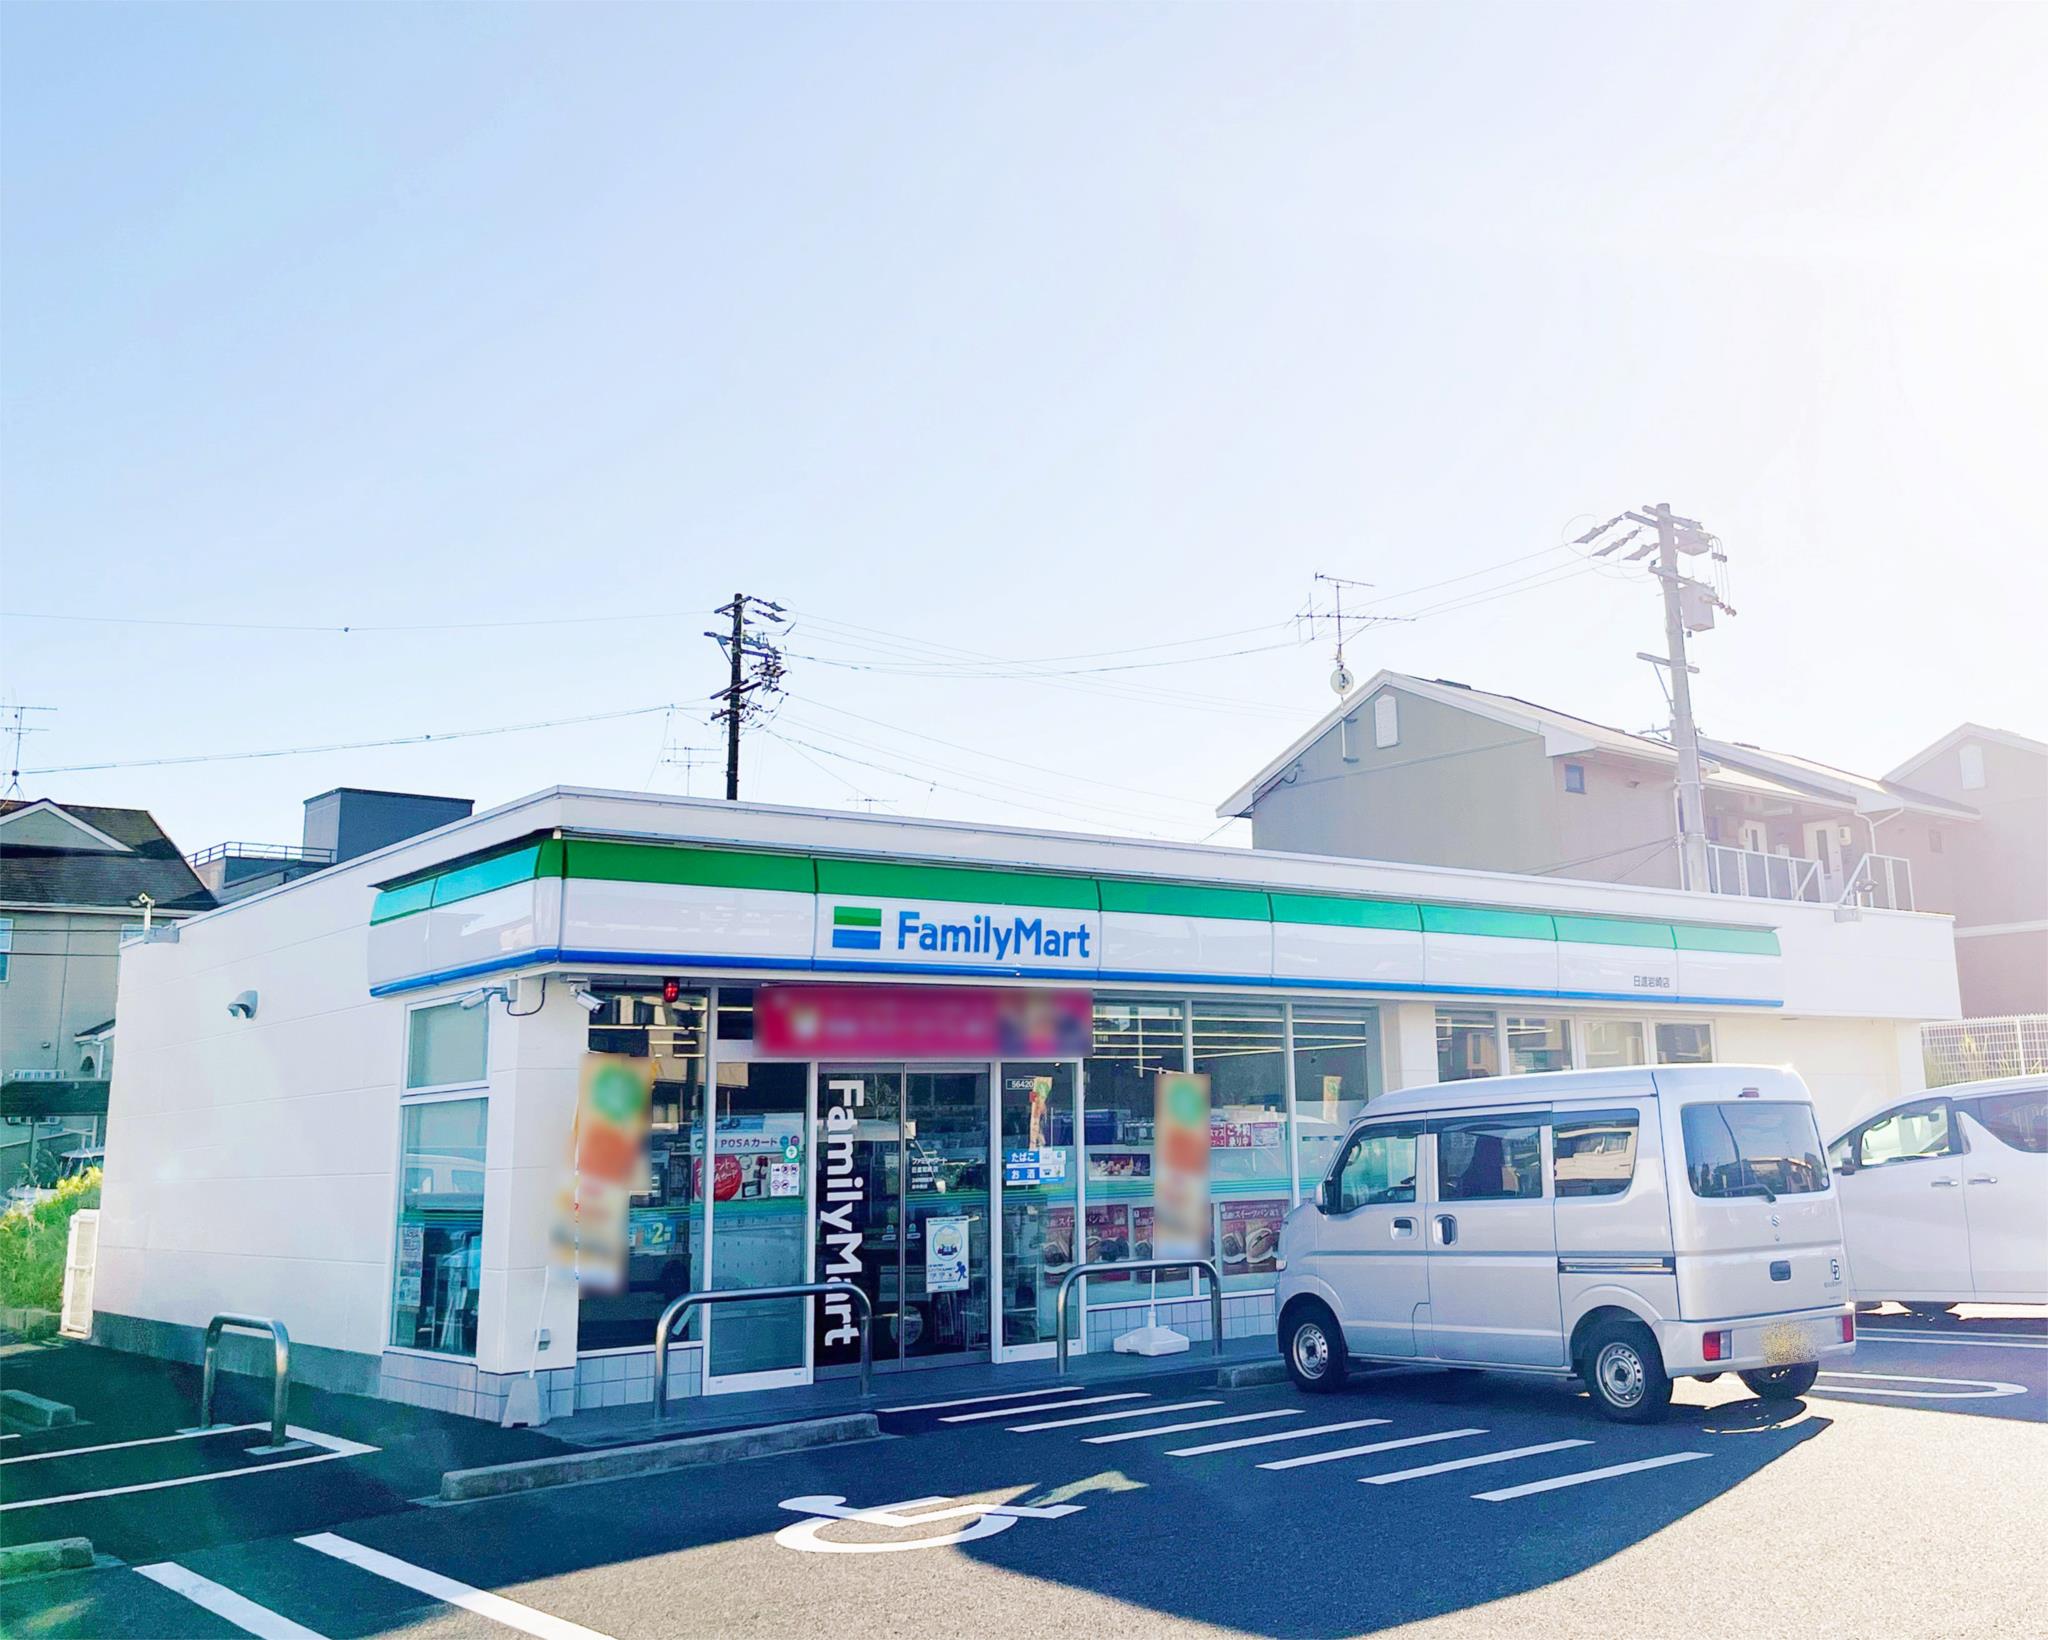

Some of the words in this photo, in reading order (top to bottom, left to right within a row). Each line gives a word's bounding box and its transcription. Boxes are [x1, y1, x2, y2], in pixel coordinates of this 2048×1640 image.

[898, 911, 1090, 960] FamilyMart
[720, 1137, 778, 1148] POSAカード
[1011, 1151, 1036, 1163] たばこ
[820, 1079, 864, 1346] FamilyMart
